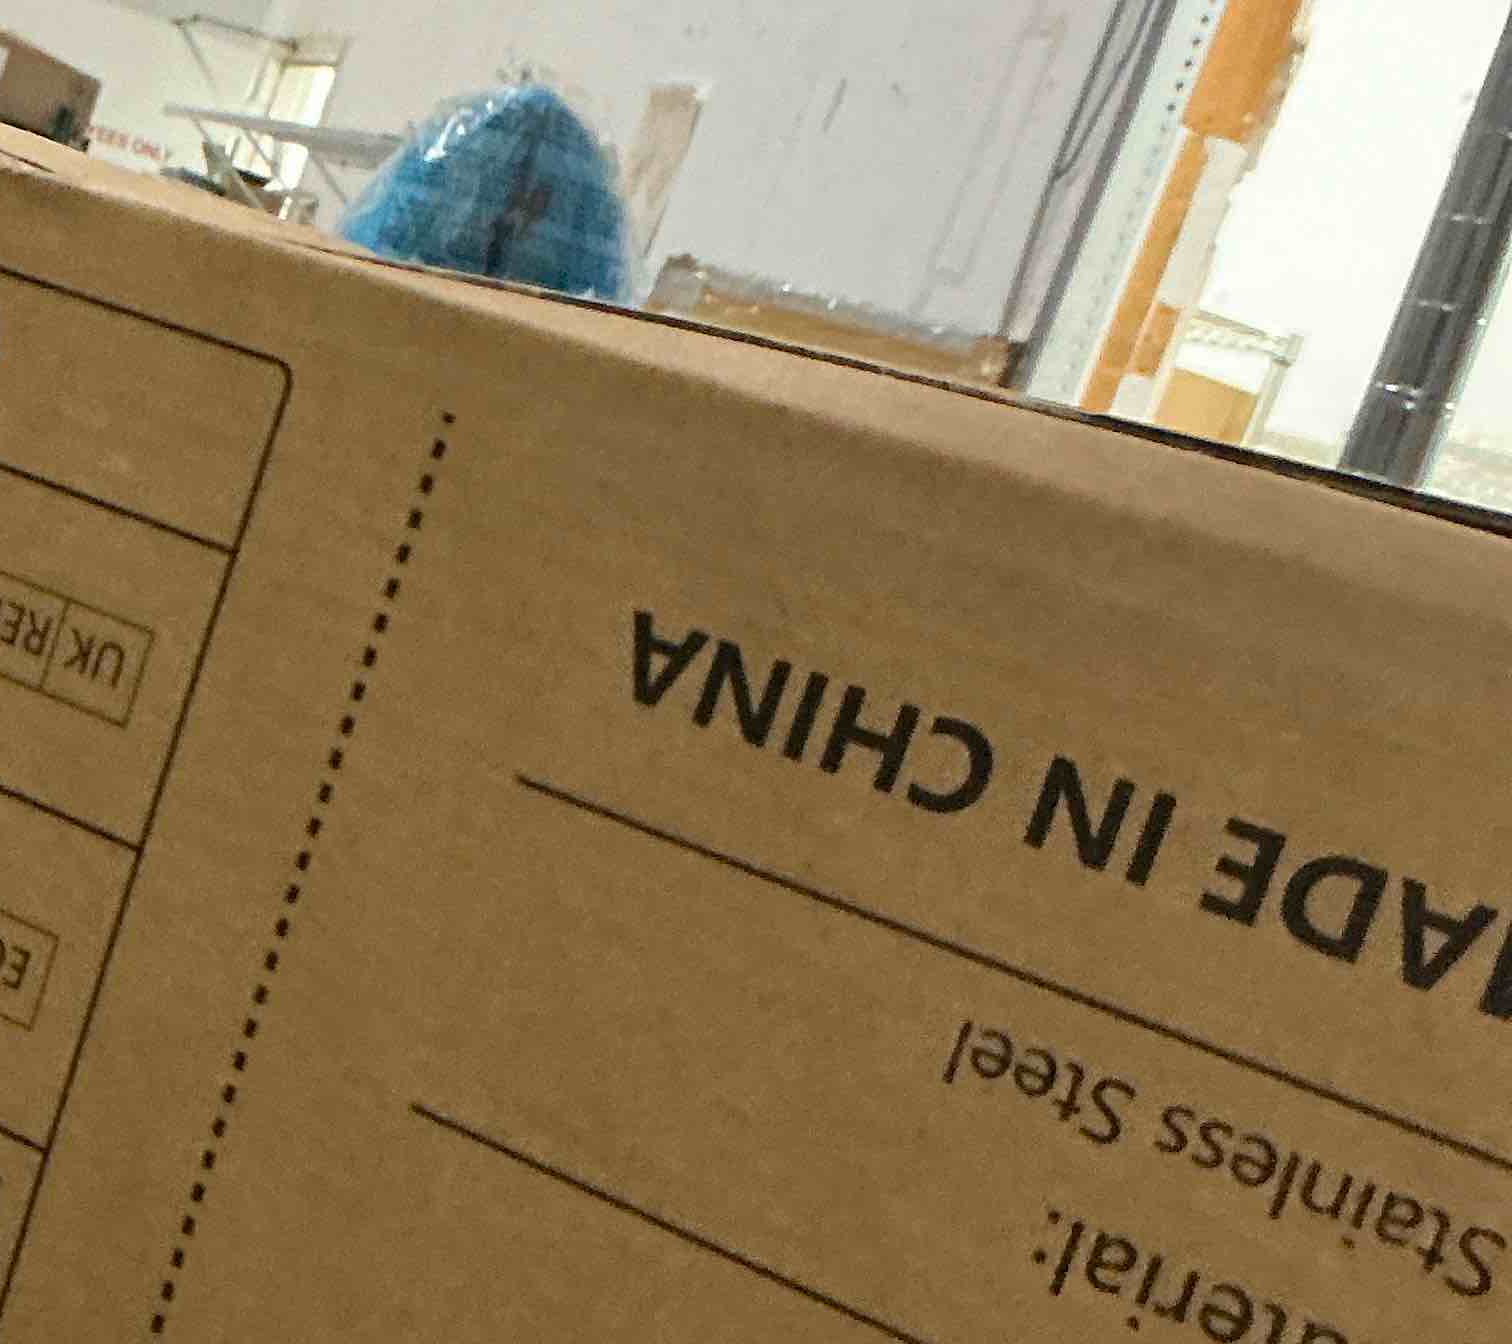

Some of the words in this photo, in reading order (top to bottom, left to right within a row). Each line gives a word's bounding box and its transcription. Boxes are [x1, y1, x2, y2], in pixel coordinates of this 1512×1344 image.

[61, 627, 129, 689] UK
[632, 609, 994, 814] CHINA
[1022, 755, 1177, 887] IN
[941, 1019, 1136, 1146] Steel
[1154, 1104, 1508, 1301] Stainless
